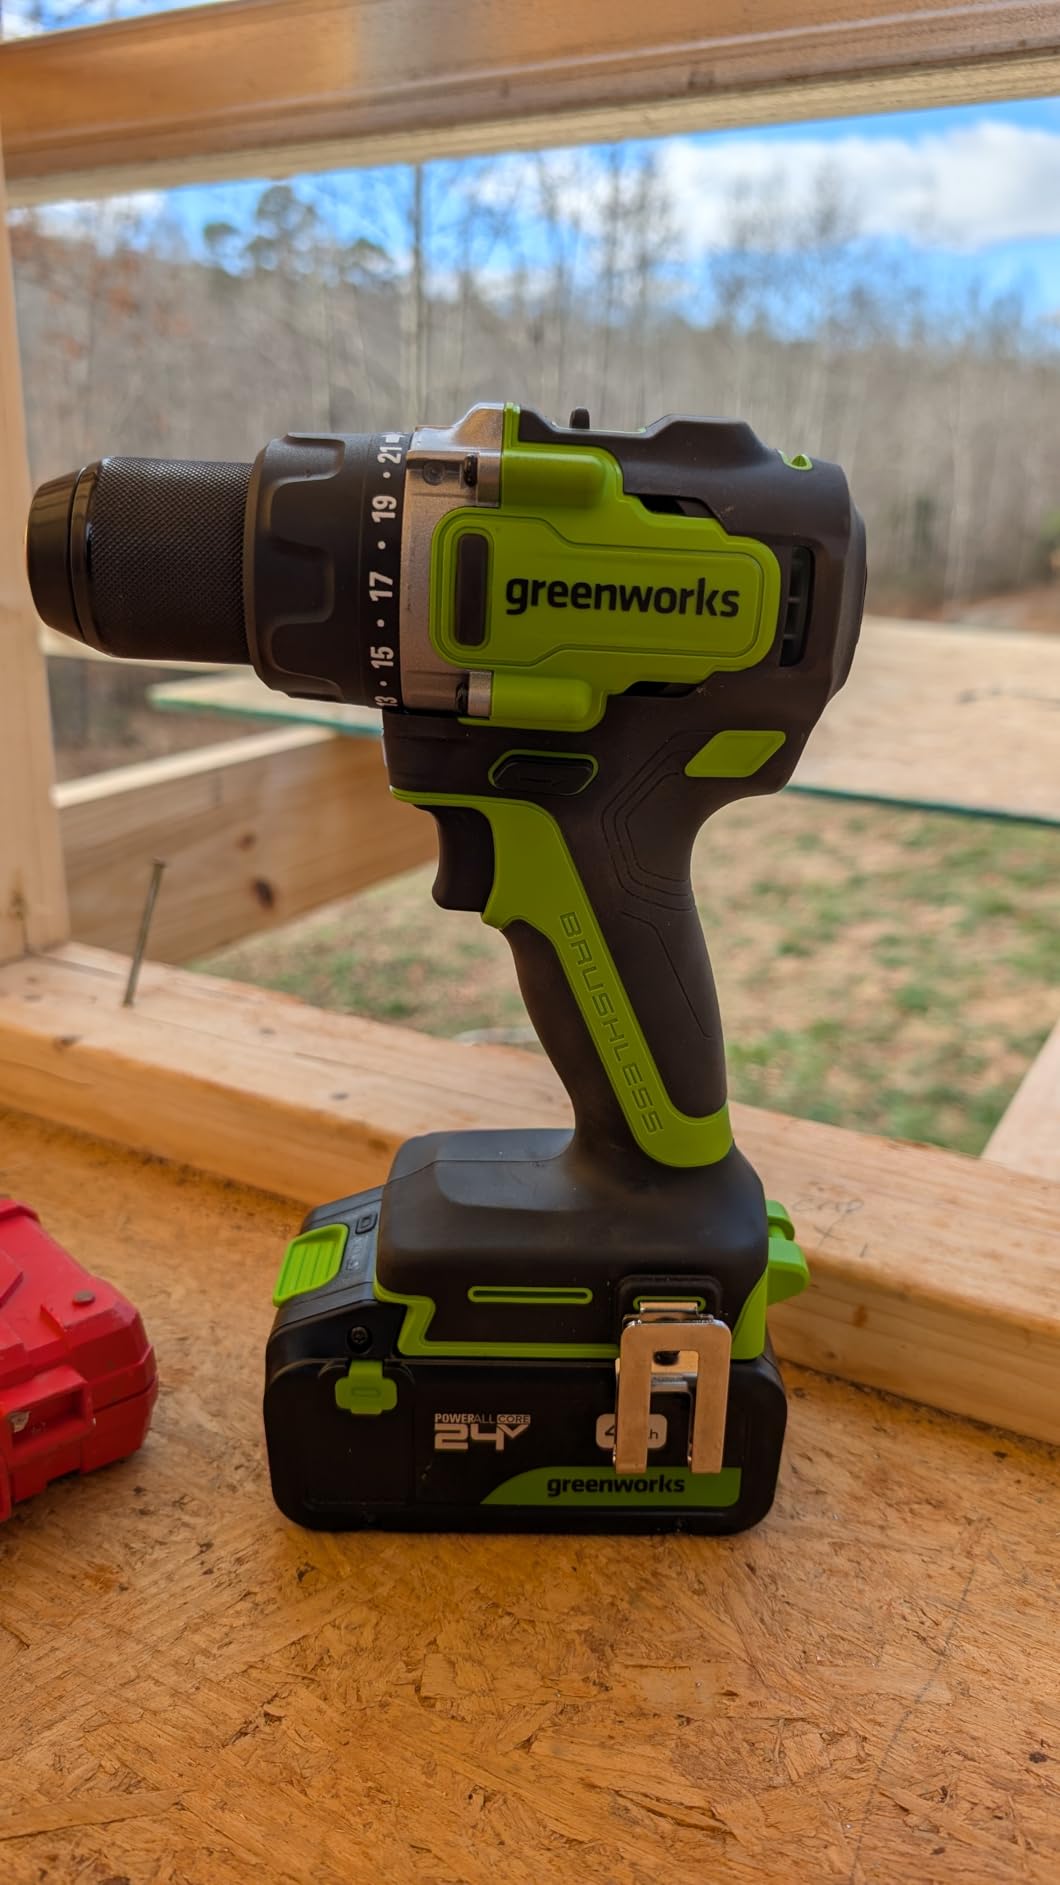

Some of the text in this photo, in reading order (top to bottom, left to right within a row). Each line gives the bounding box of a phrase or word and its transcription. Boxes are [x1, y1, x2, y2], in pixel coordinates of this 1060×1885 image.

[377, 446, 402, 464] 21
[371, 495, 397, 523] 19
[369, 571, 393, 601] 17
[505, 577, 740, 618] greenworks
[370, 646, 394, 668] 15
[559, 911, 664, 1133] BRUSHLESS
[434, 1413, 531, 1424] POWERALL CORE
[434, 1423, 530, 1450] 24V
[546, 1474, 686, 1498] greenworks
